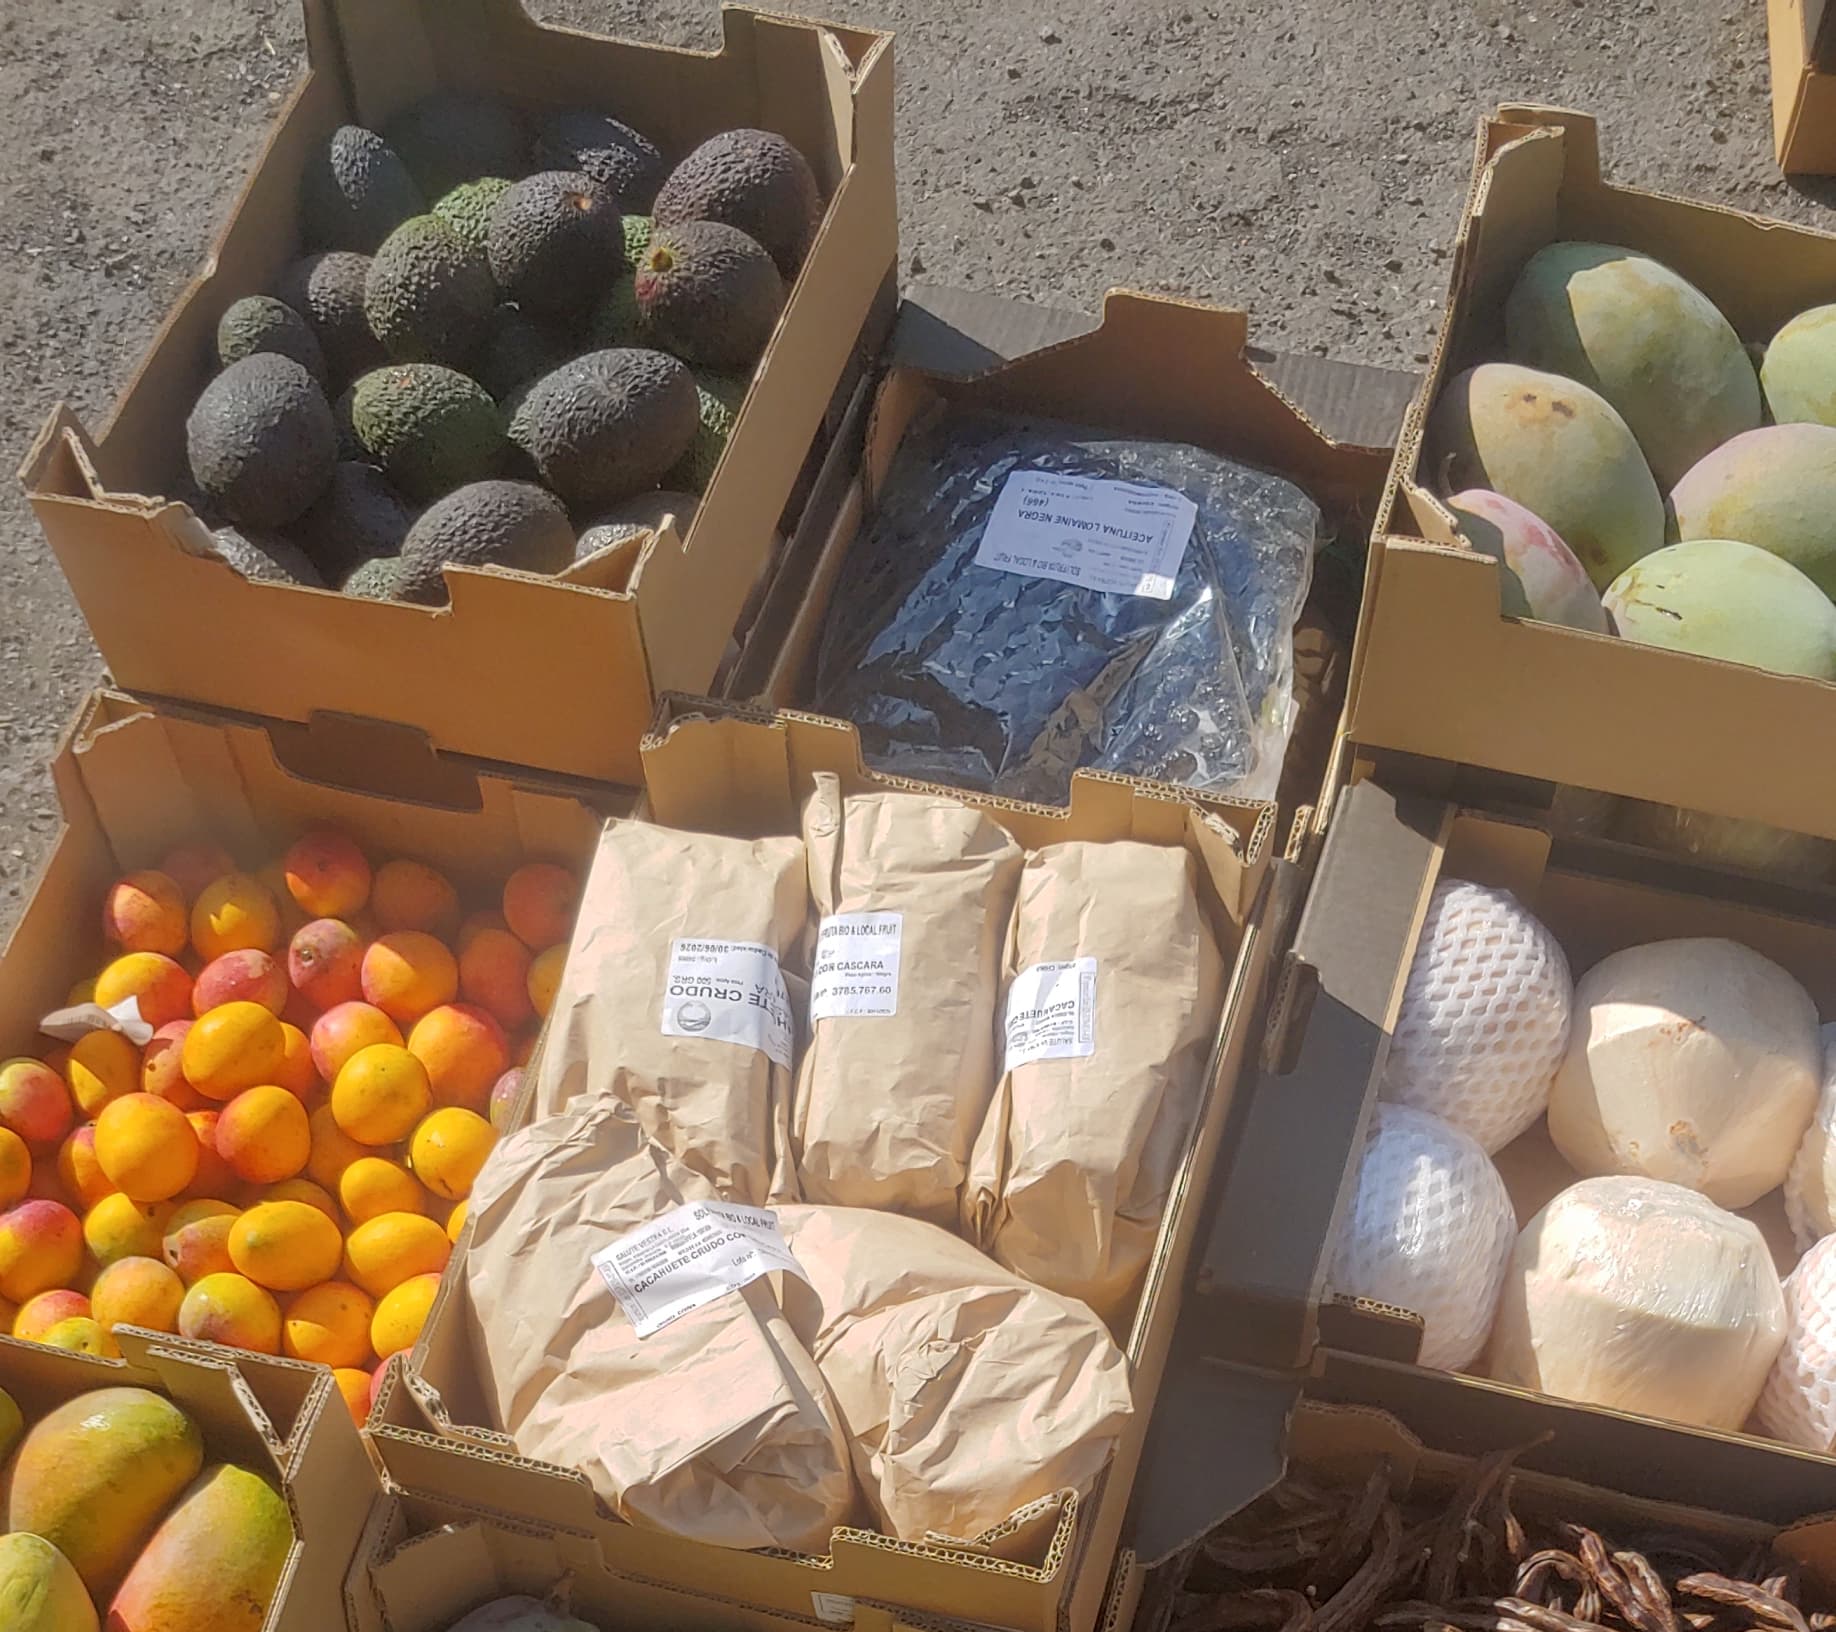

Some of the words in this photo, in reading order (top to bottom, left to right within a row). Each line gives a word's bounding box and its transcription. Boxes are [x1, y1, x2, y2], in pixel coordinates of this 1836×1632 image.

[1018, 509, 1053, 522] NEGRA
[1054, 516, 1100, 531] LOMAINE
[1103, 524, 1153, 544] ACEITUNA
[839, 925, 850, 936] BIO
[857, 925, 877, 936] LOCAL
[879, 924, 897, 935] FRUIT
[836, 961, 884, 971] CASCARA
[670, 985, 742, 1002] CRUDO
[634, 1254, 691, 1294] CACAHUETE
[691, 1238, 726, 1260] CRUDO
